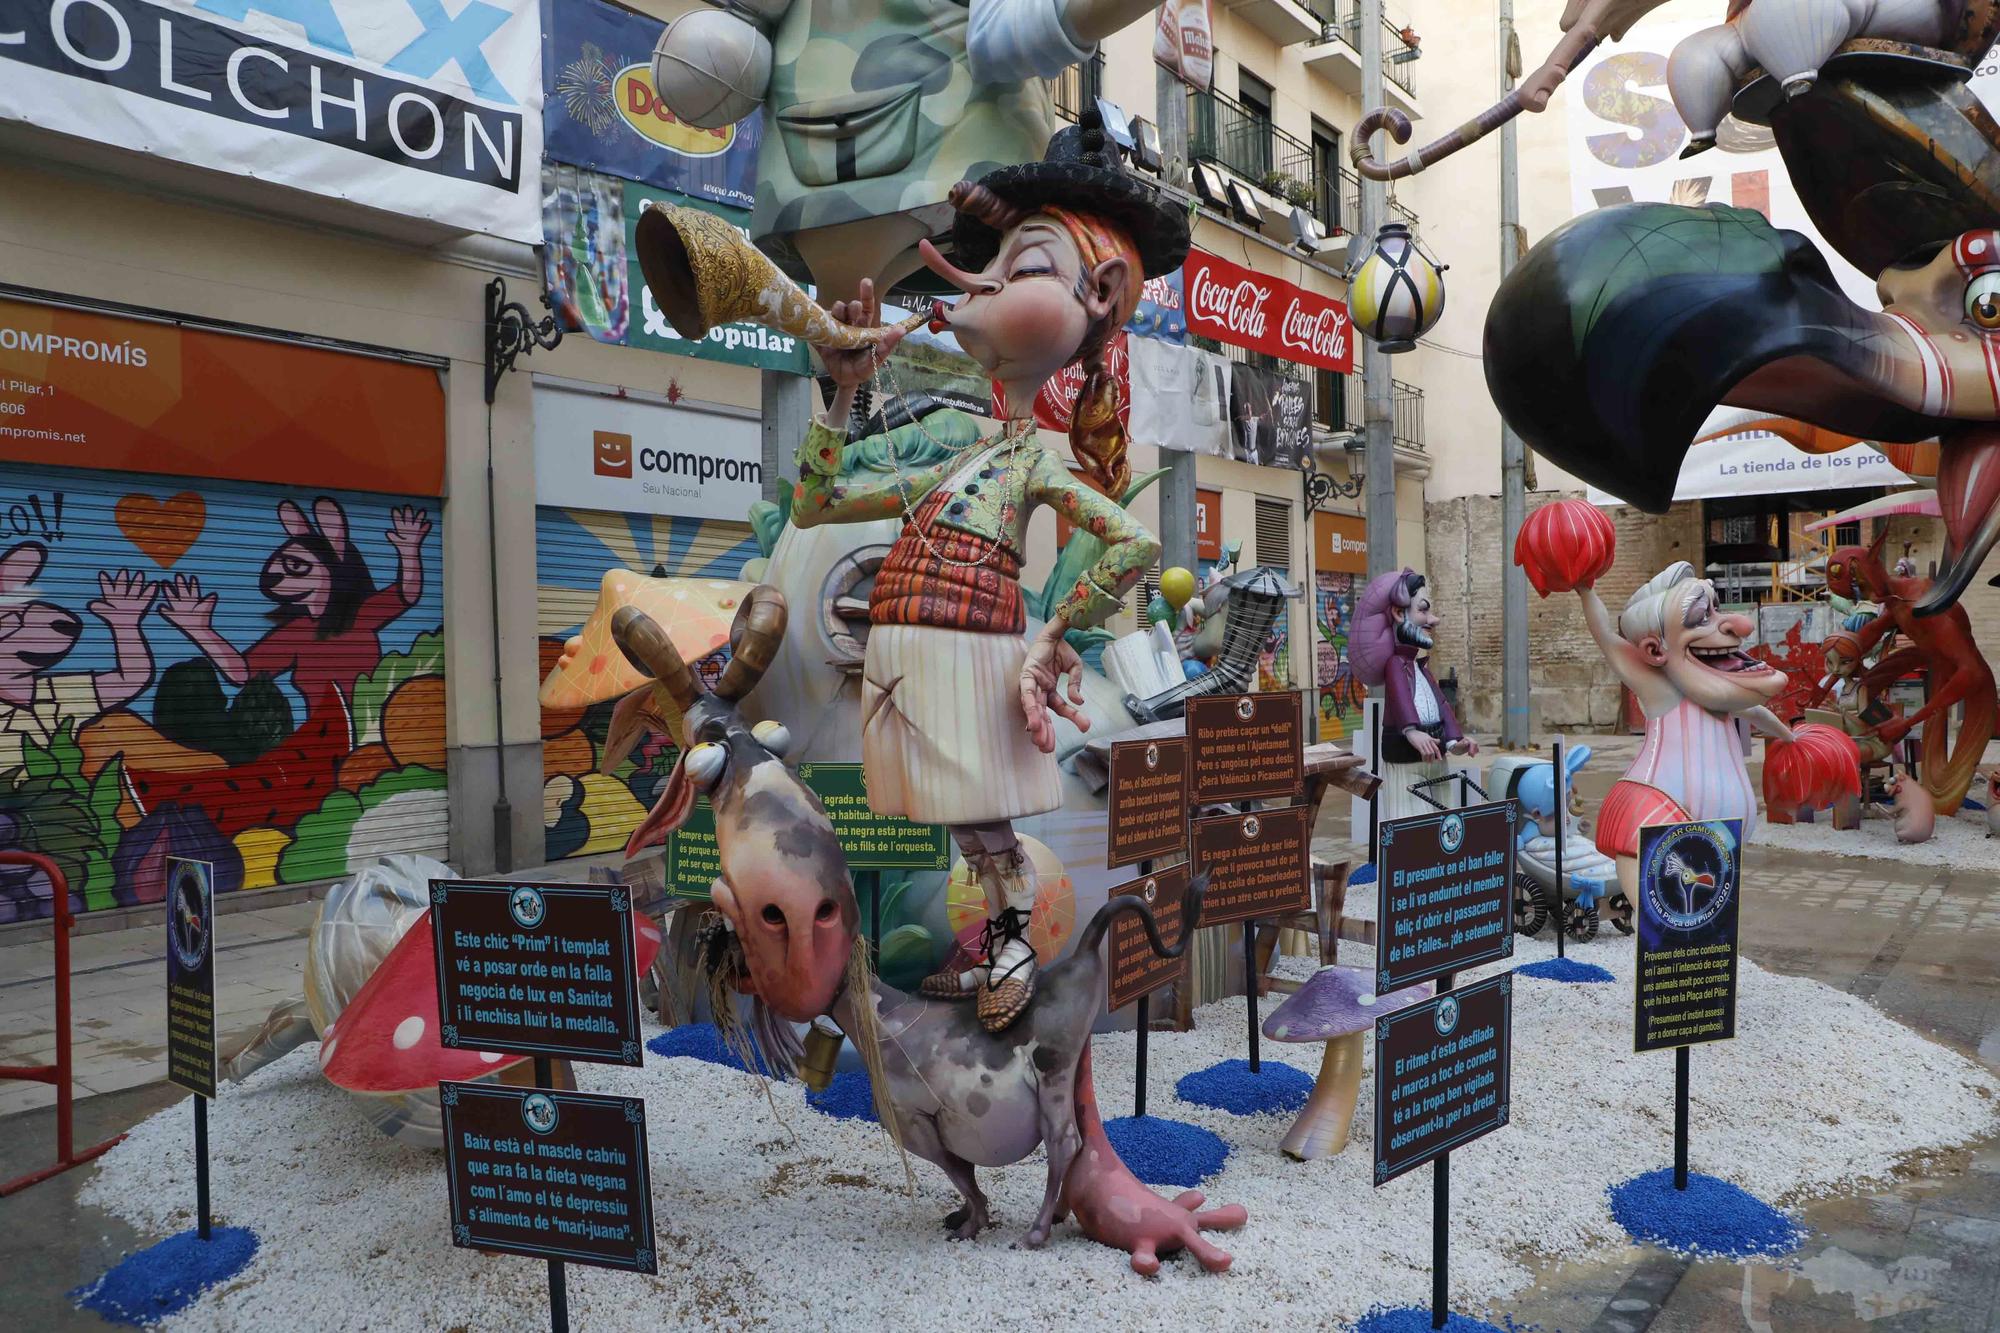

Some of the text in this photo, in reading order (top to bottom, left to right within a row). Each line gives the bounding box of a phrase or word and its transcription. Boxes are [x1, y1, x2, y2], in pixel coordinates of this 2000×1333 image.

[0, 0, 513, 181] OLCHON
[703, 183, 755, 203] www.arroz
[1192, 267, 1273, 339] Coca-Cola
[1282, 298, 1348, 360] Coca-Cola
[0, 328, 148, 368] OMPROMÍS
[10, 380, 55, 397] Pilar, 1
[0, 426, 87, 443] mpromis.net
[640, 448, 763, 486] comprom
[1720, 454, 1887, 476] La tienda de los pro
[642, 482, 703, 499] Seu Nacional
[824, 794, 855, 807] agrada
[839, 810, 873, 820] habitual
[678, 829, 716, 843] Sempre que
[845, 841, 858, 852] els
[860, 841, 876, 852] fills
[878, 841, 889, 852] de
[851, 828, 876, 839] negra
[878, 826, 897, 836] està
[898, 826, 931, 839] present
[1393, 850, 1504, 888] Ell presumix en el ban faller
[1391, 873, 1504, 912] i se li va endurint el membre
[1649, 882, 1731, 928] Falla Plaça del Pilar 2020
[1394, 918, 1414, 937] feliç
[1444, 907, 1452, 923] el
[1453, 898, 1500, 925] passacarrer
[454, 930, 480, 948] Este
[483, 932, 509, 950] chic
[553, 936, 558, 952] i
[561, 937, 610, 959] templat
[1389, 917, 1503, 962] de les Falles... ¡de setembre!
[456, 955, 612, 981] vé a posar orde en la falla
[459, 982, 613, 1007] negocia de lux en Sanitat
[457, 1004, 619, 1034] i li enchisa lluïr la medalla.
[1395, 1058, 1404, 1076] El
[1406, 1052, 1429, 1072] ritme
[1458, 1024, 1494, 1050] desfilada
[1391, 1047, 1496, 1101] el marca a toc de corneta
[1393, 1069, 1494, 1125] té a la tropa ben vigilada
[1390, 1089, 1496, 1150] observant-la ¡per la dreta!
[463, 1132, 626, 1165] Baix està el mascle cabriu
[467, 1160, 626, 1192] que ara fa la dieta vegana
[470, 1184, 496, 1199] com
[535, 1189, 546, 1206] el
[549, 1191, 563, 1208] té
[566, 1193, 628, 1216] depressiu
[534, 1213, 549, 1230] de
